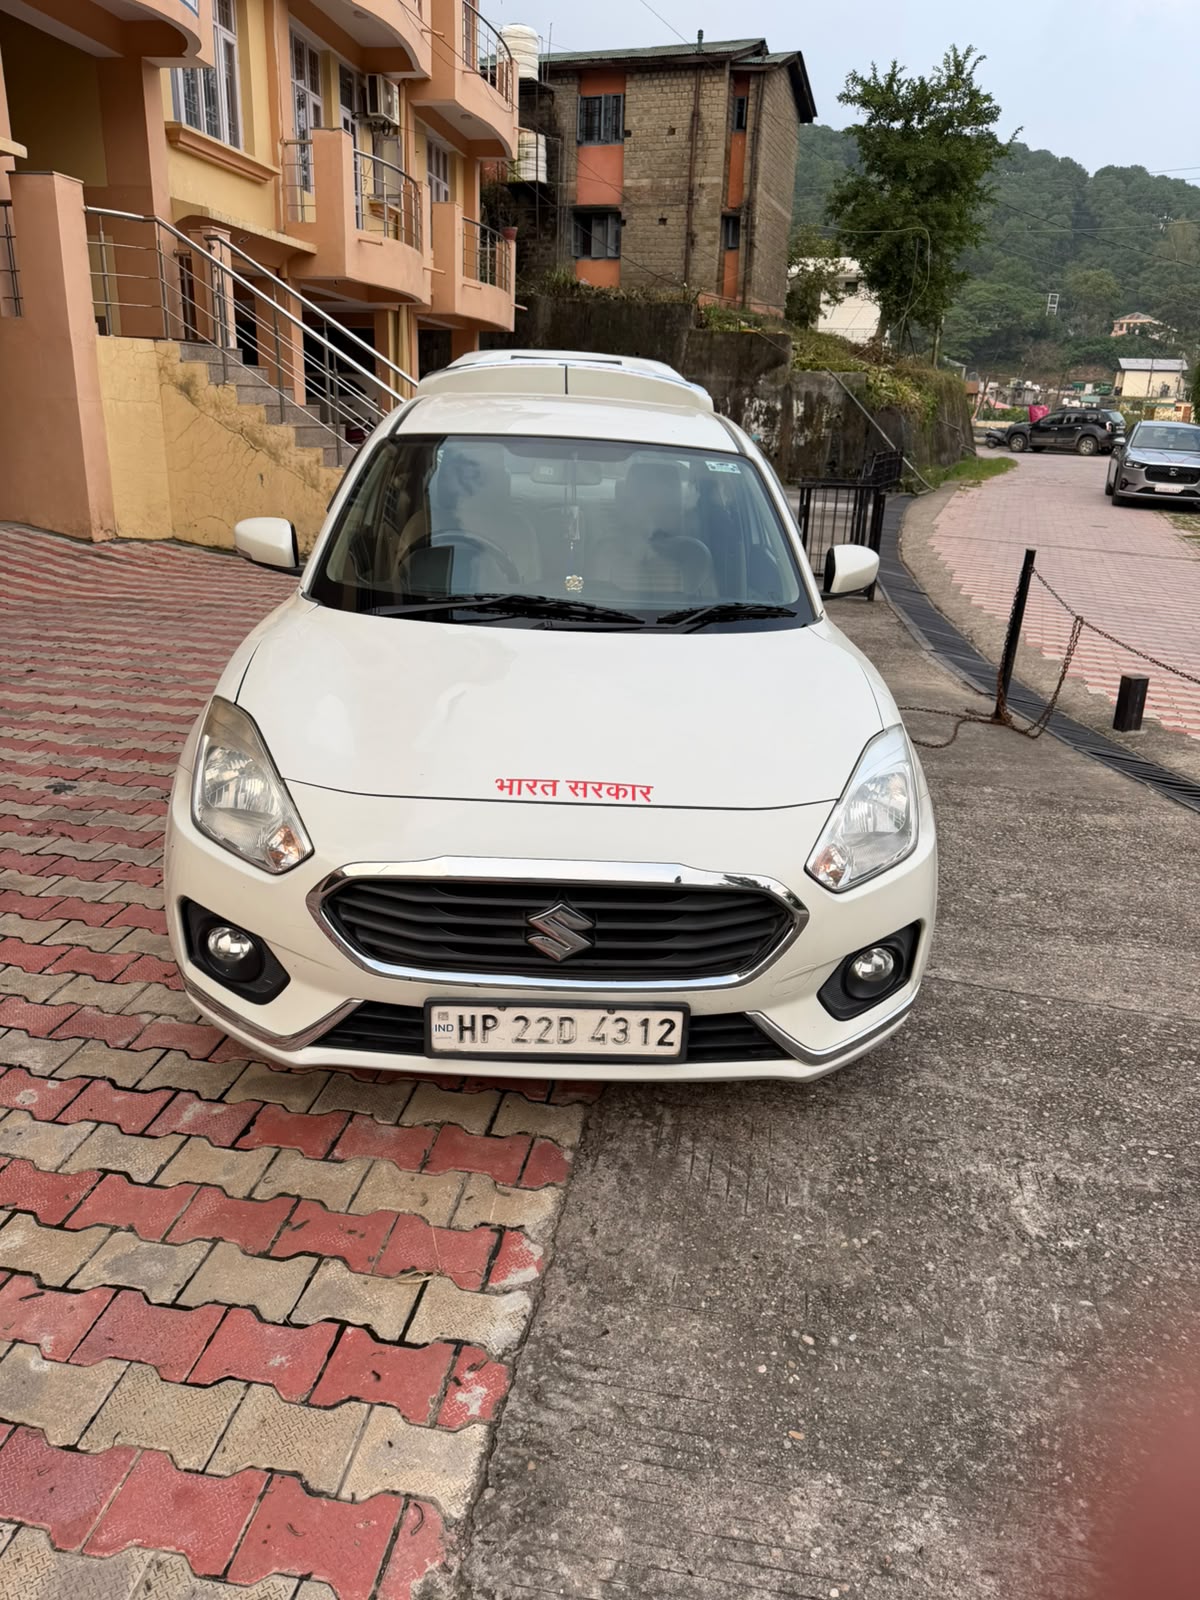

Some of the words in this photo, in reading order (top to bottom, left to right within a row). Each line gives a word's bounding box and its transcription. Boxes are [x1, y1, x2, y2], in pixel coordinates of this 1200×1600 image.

[495, 778, 560, 797] भारत
[565, 780, 654, 802] सरकार
[434, 1024, 454, 1033] IND
[457, 1014, 498, 1043] HP
[588, 1016, 676, 1047] 4312
